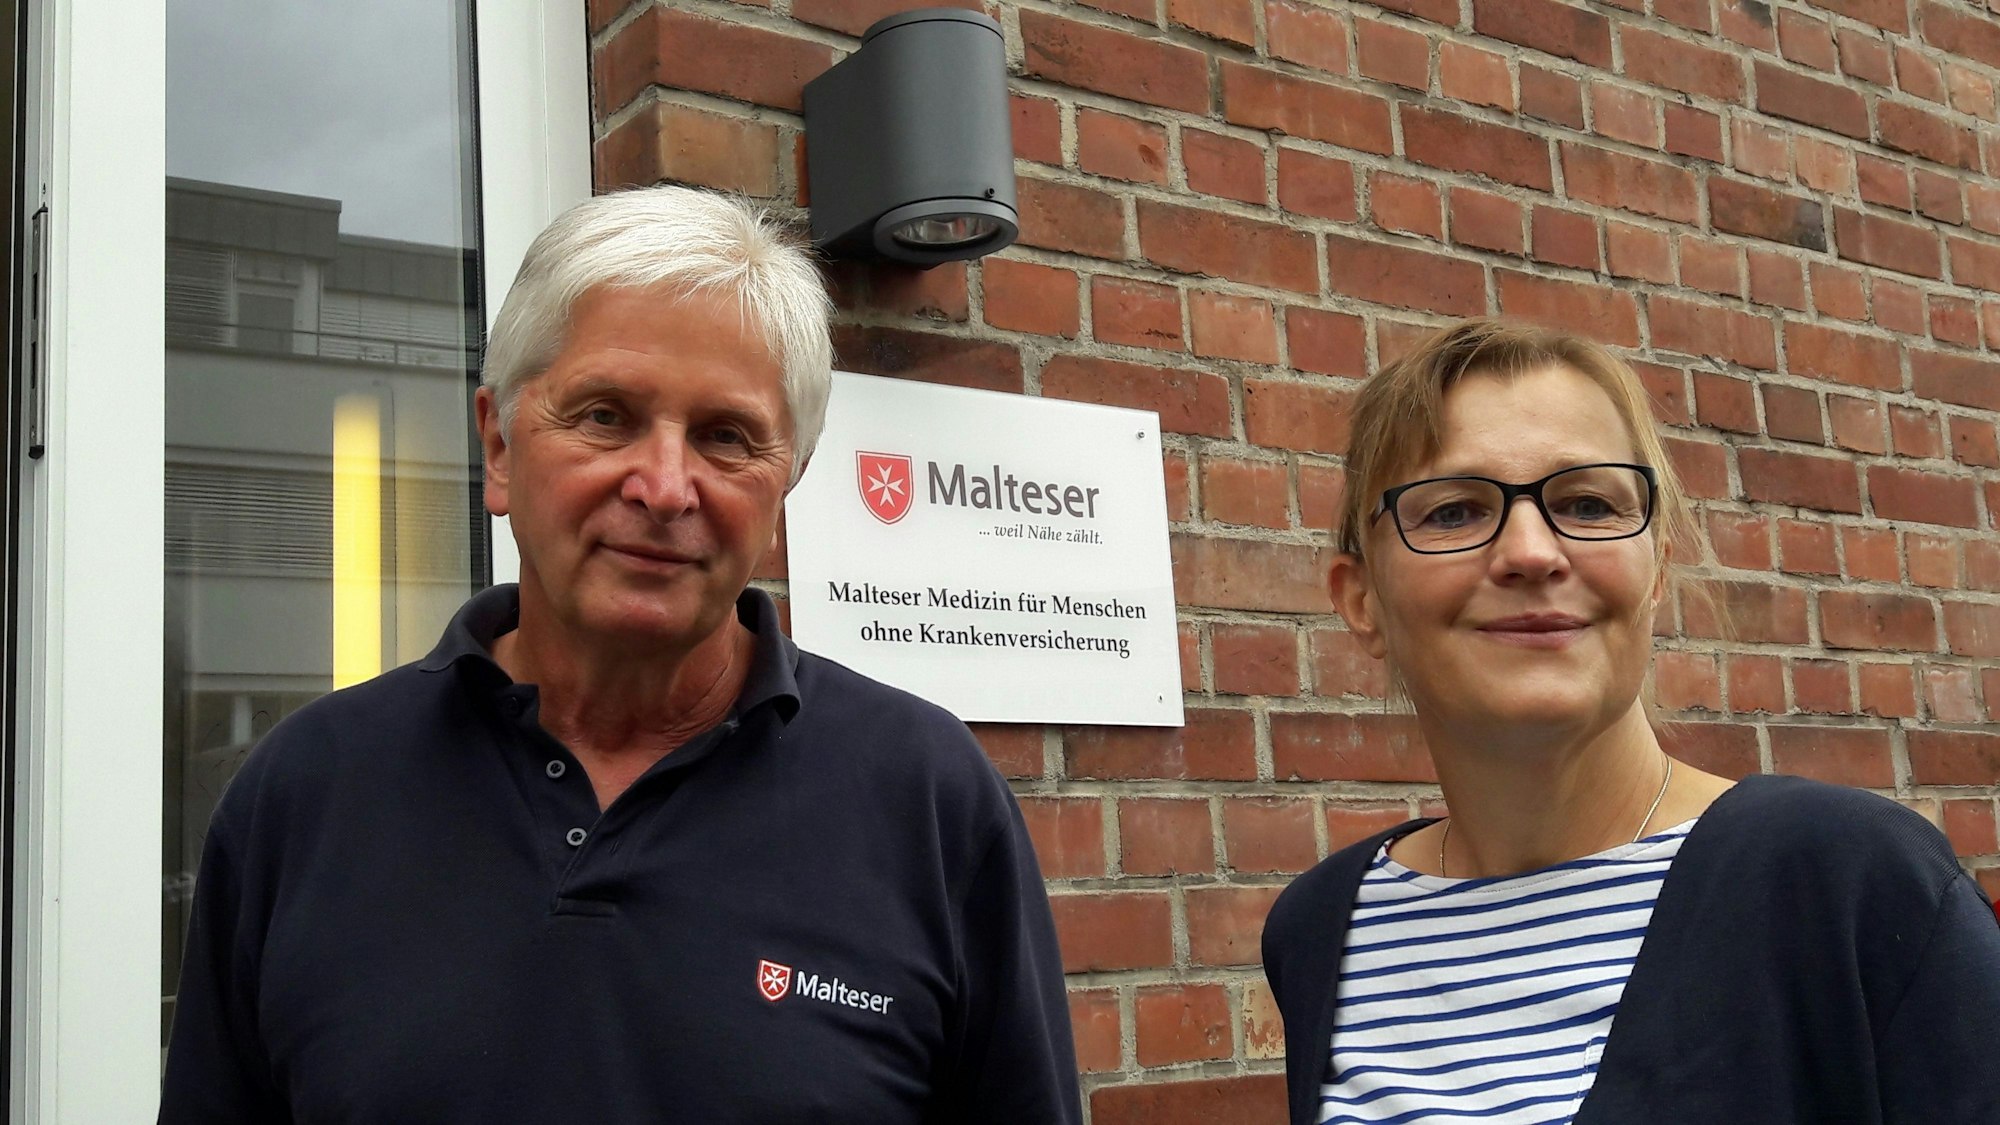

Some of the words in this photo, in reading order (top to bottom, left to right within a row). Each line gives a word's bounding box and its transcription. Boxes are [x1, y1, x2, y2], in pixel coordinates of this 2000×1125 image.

[927, 460, 1100, 519] Malteser
[994, 523, 1024, 538] weil
[1027, 524, 1062, 541] Nähe
[1066, 529, 1103, 545] zählt.
[827, 581, 922, 607] Malteser
[926, 586, 1013, 612] Medizin
[1017, 592, 1047, 614] für
[1051, 594, 1147, 620] Menschen
[860, 619, 913, 643] ohne
[918, 622, 1131, 659] Krankenversicherung
[796, 970, 894, 1015] Malteser
